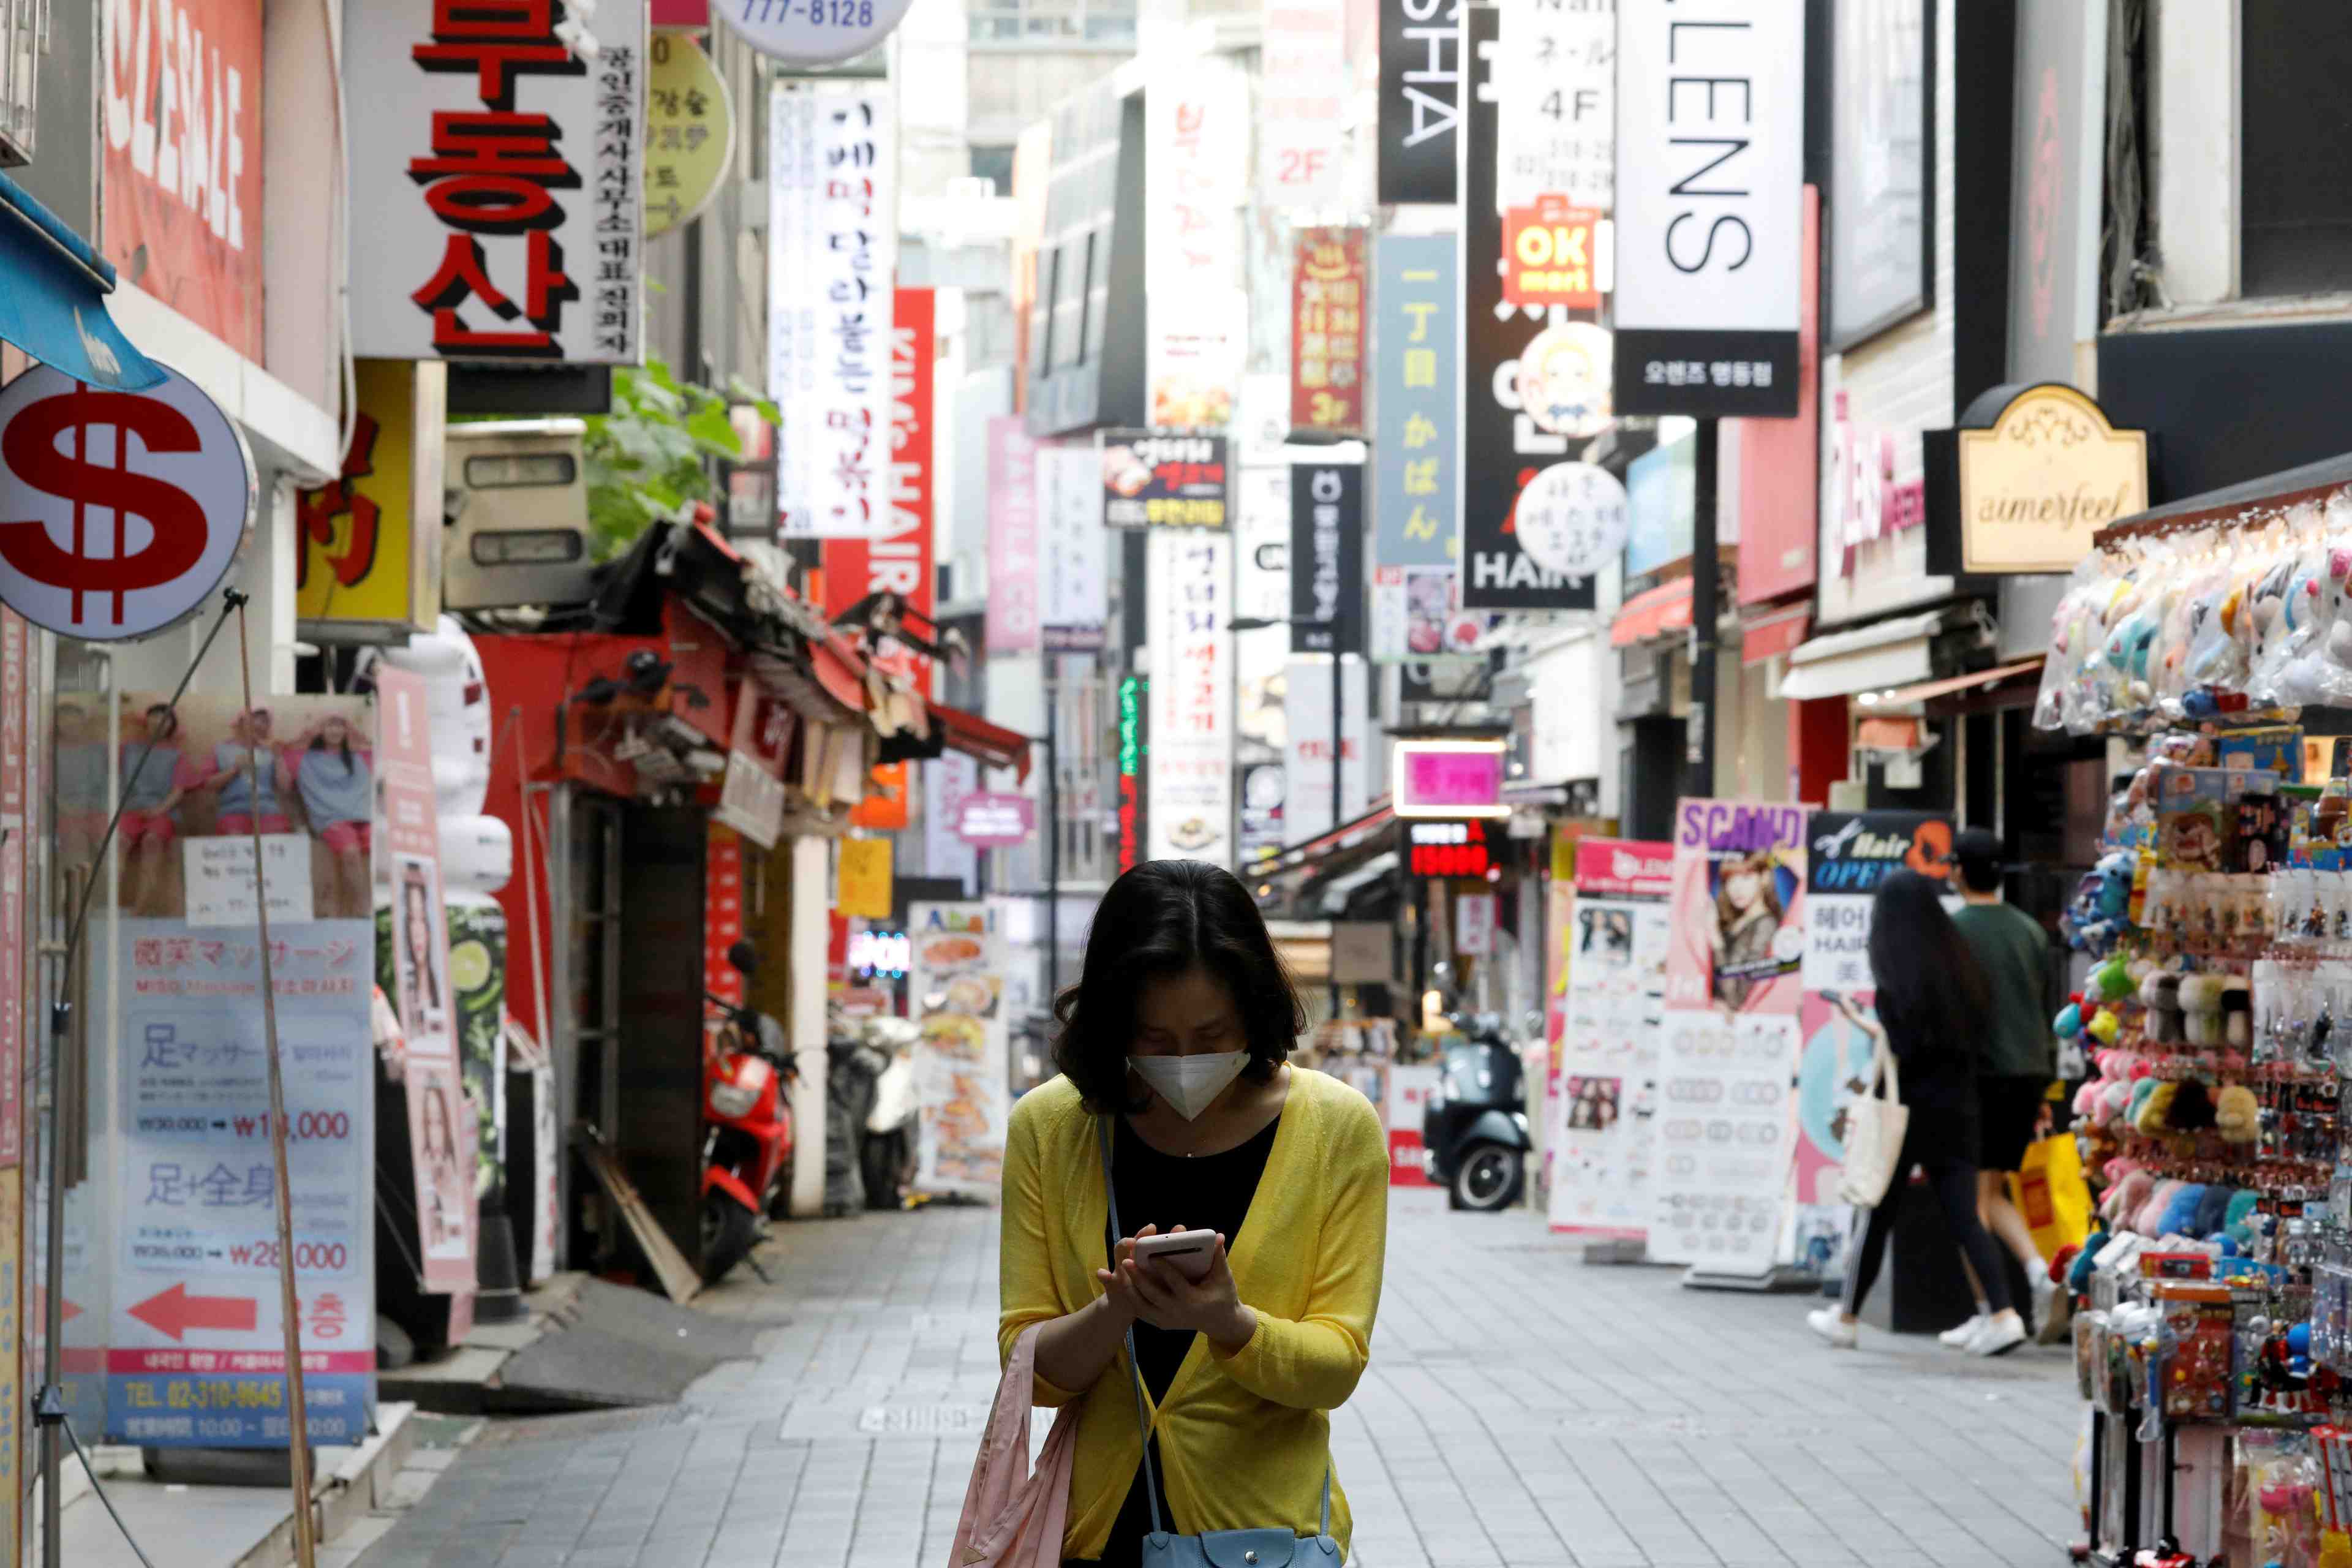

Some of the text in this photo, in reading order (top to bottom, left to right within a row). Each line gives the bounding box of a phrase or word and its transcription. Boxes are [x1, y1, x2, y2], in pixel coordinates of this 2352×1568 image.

[1539, 89, 1600, 122] 4F
[407, 0, 585, 357] 부동산
[1279, 148, 1329, 184] 2F
[1515, 224, 1588, 267] OK
[1519, 265, 1589, 293] mart
[870, 461, 922, 597] HAIR
